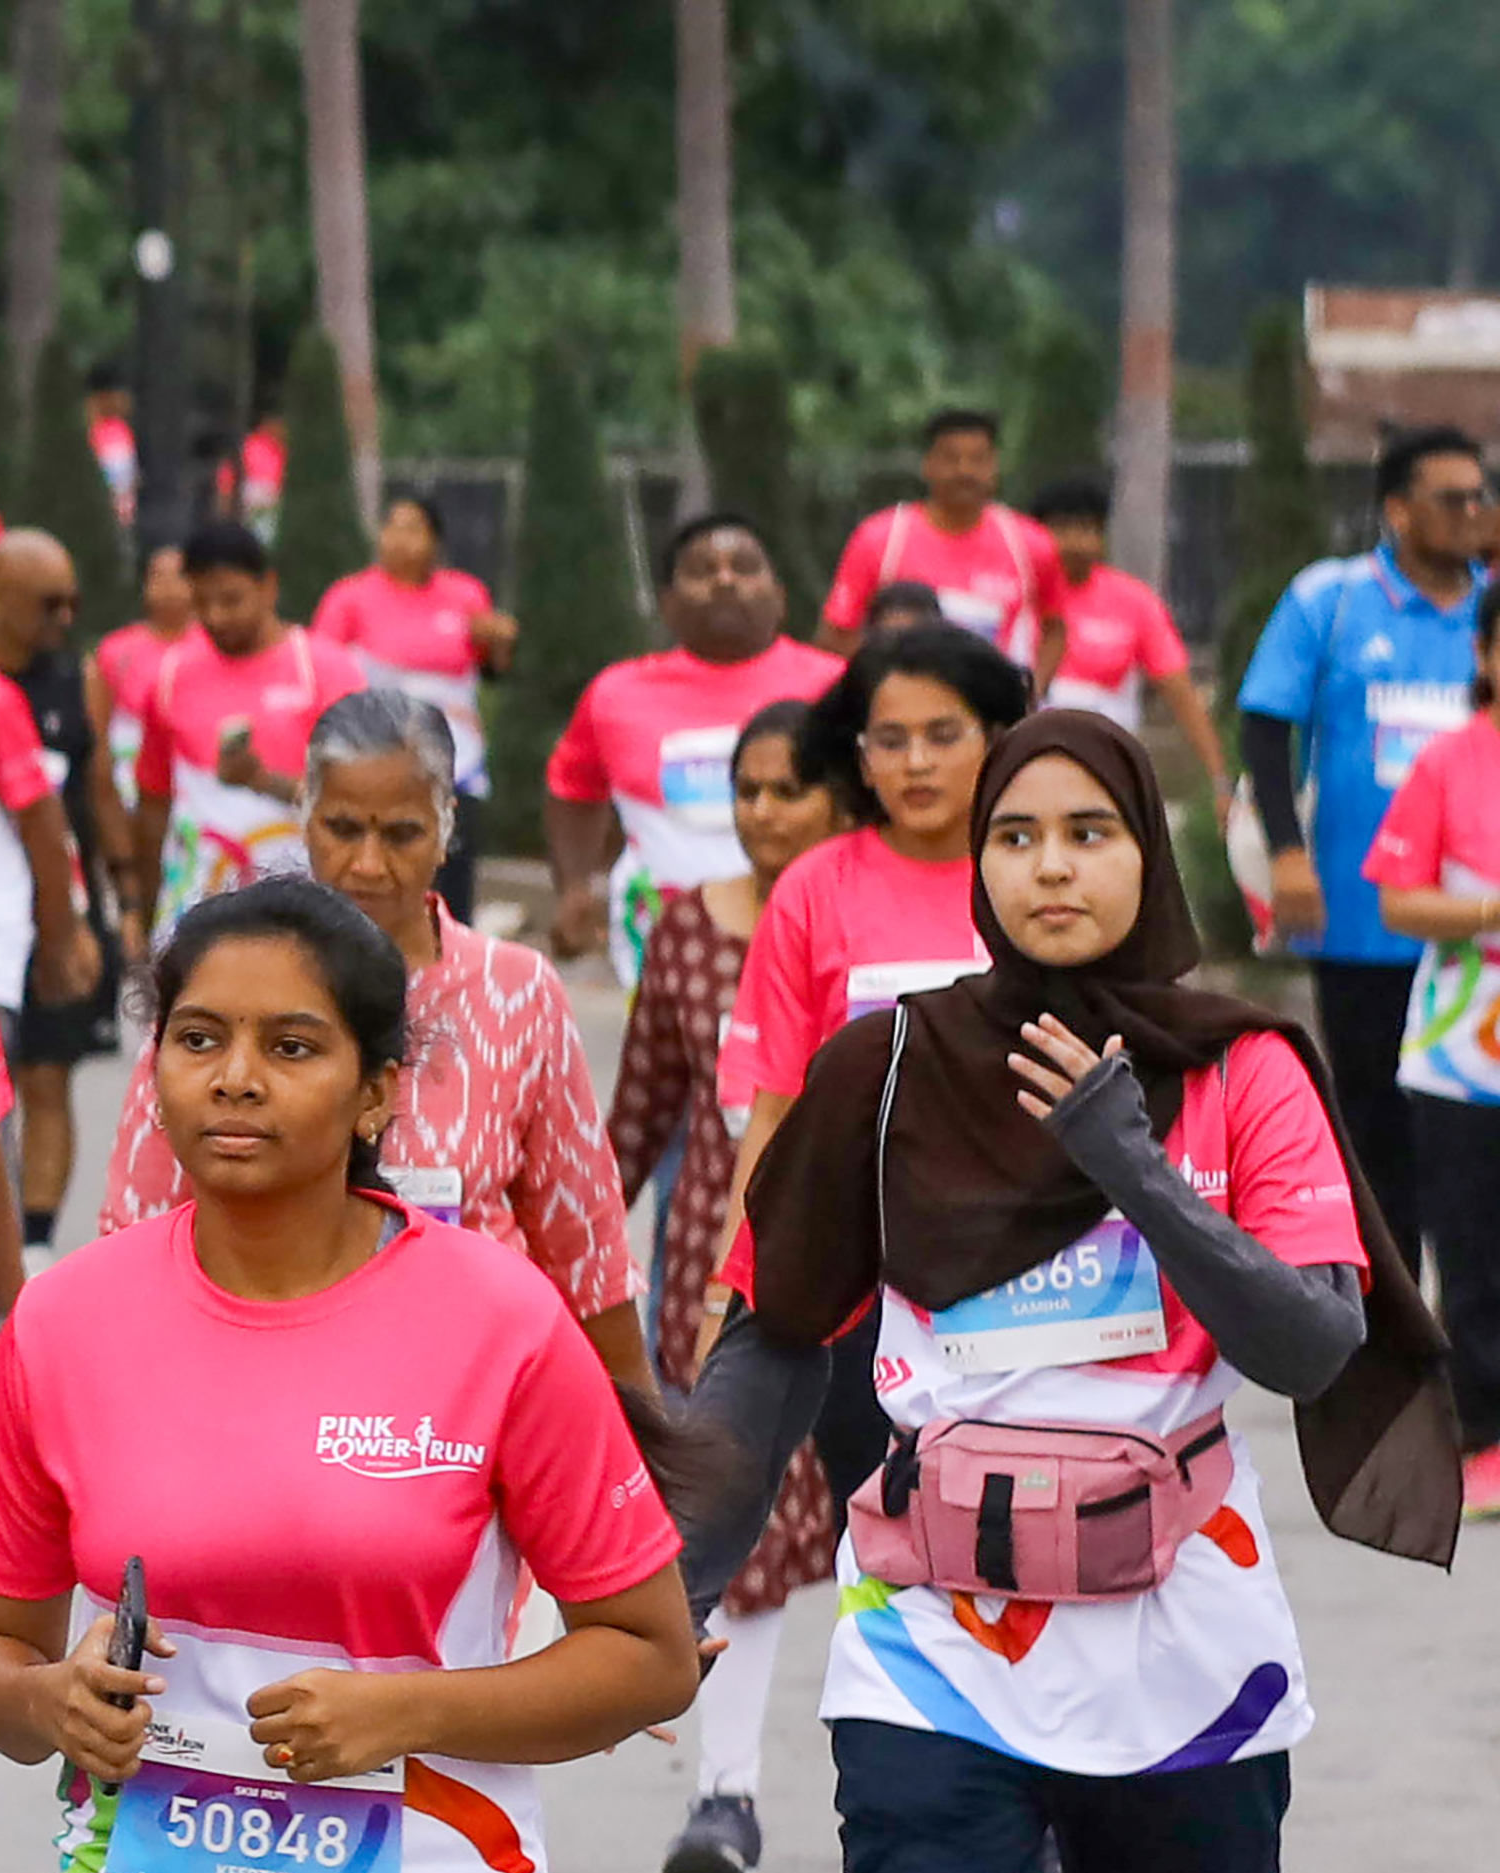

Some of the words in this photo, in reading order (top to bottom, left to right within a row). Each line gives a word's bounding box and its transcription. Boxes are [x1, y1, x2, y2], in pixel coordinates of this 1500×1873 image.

[318, 1415, 396, 1438] PINK
[315, 1436, 412, 1462] POWER
[429, 1439, 487, 1466] RUN
[166, 1795, 348, 1867] 50848
